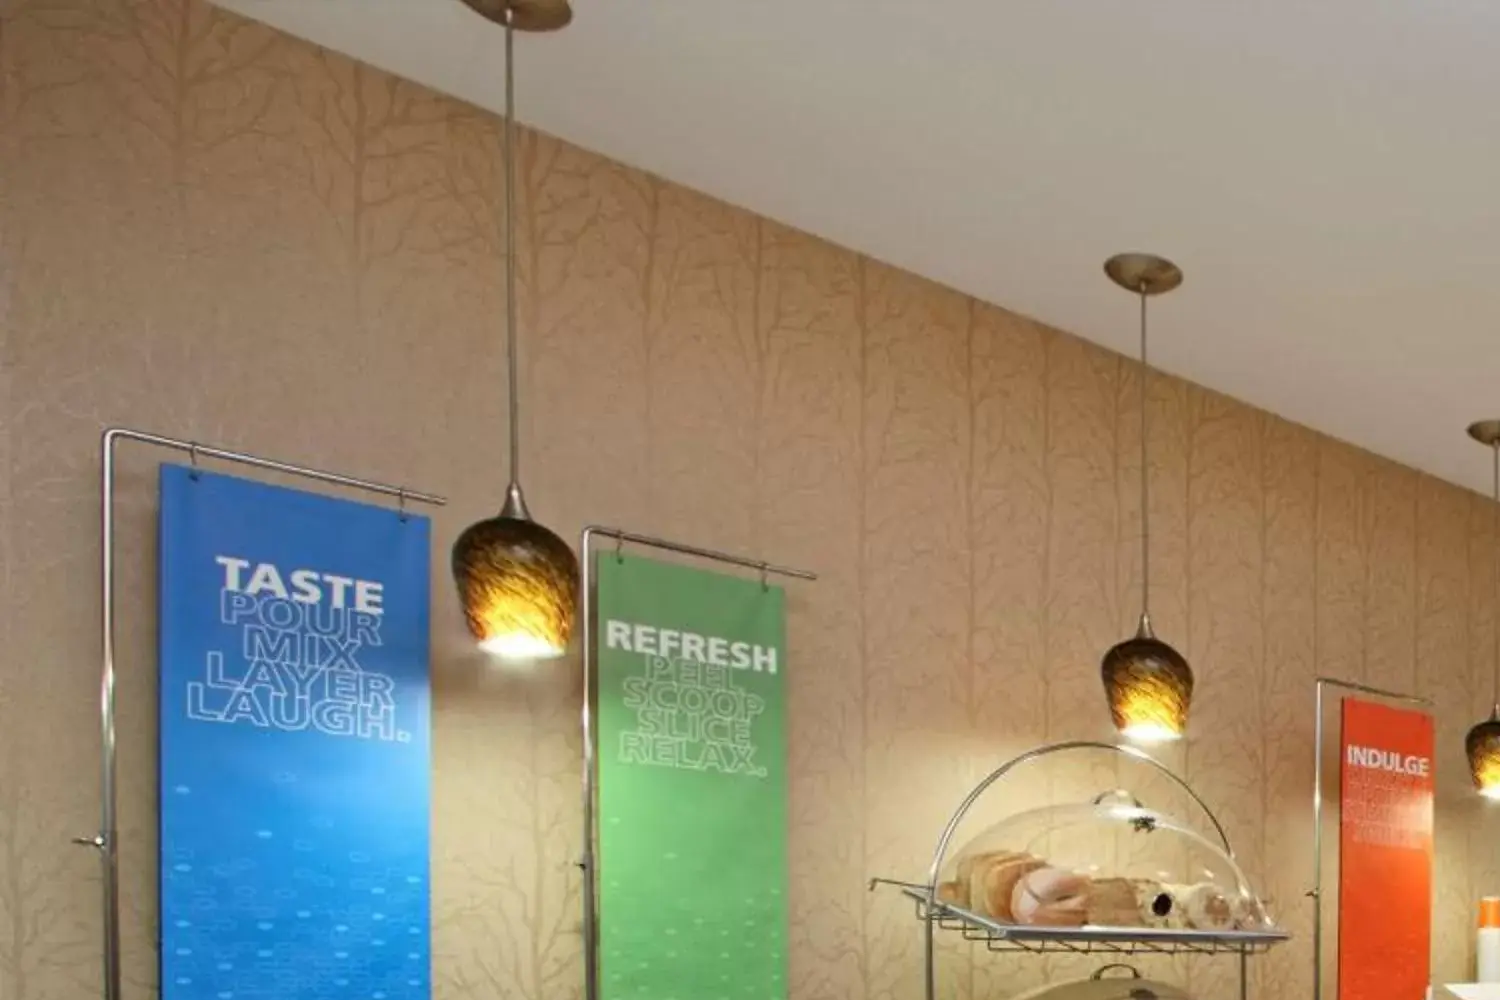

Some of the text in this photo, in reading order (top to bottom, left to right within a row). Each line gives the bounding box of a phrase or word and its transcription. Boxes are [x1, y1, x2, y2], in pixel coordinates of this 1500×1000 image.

[215, 556, 385, 615] TASTE
[220, 588, 383, 646] POUR
[243, 624, 363, 672] MIX
[606, 619, 778, 674] REFRESH
[206, 652, 396, 706] LAYER
[623, 676, 764, 719] SCOOP
[187, 682, 412, 742] LAUGH.
[637, 709, 752, 749] SLICE
[617, 731, 768, 777] RELAX.
[1347, 744, 1429, 776] INDULGE
